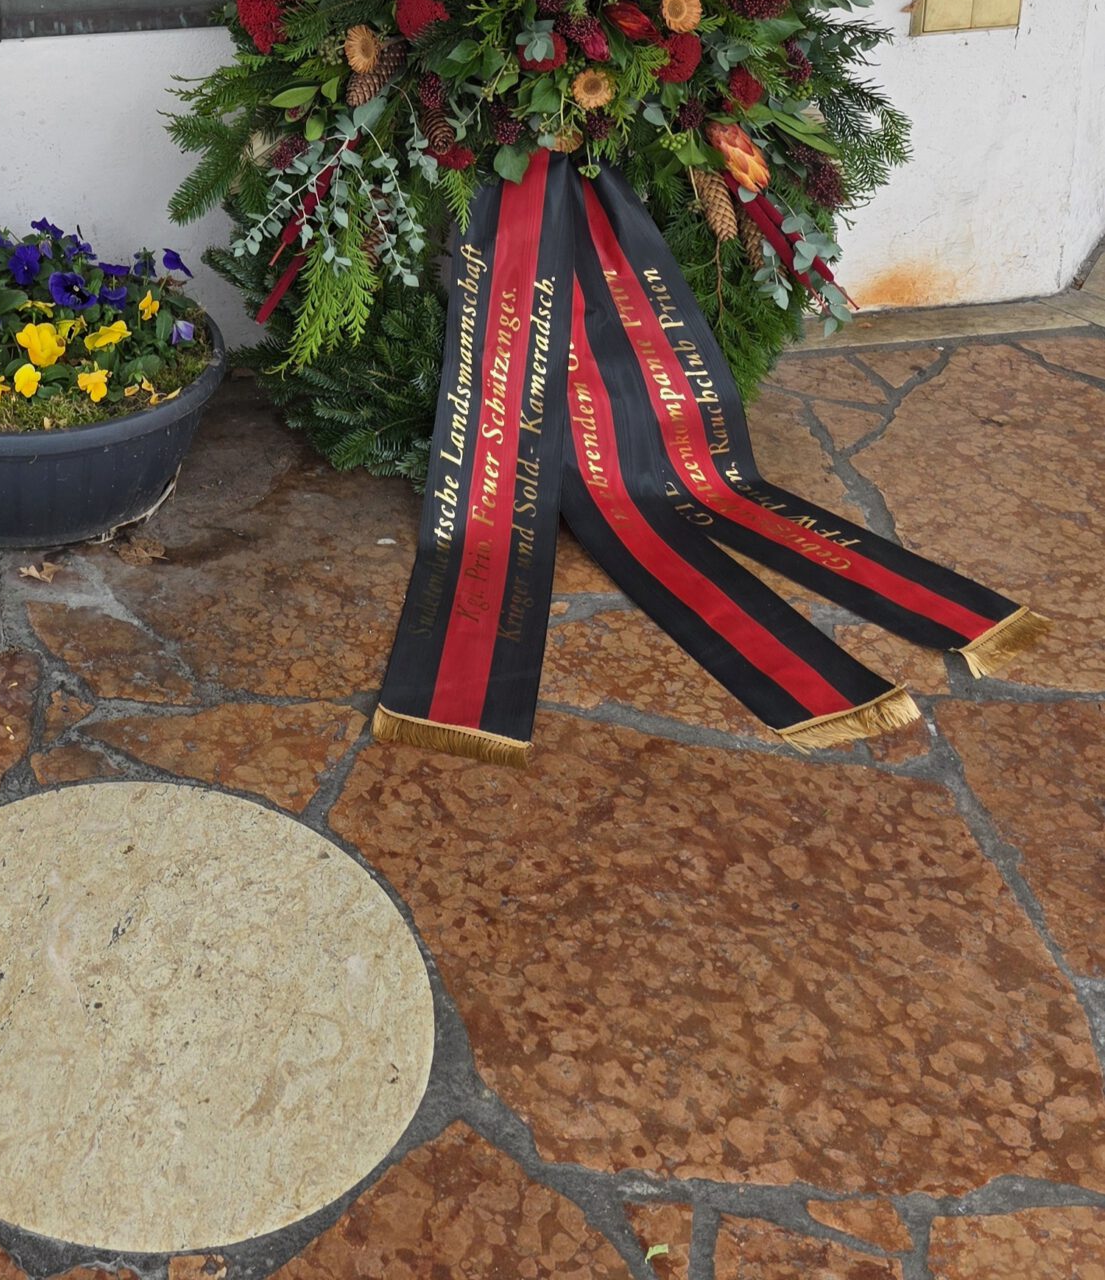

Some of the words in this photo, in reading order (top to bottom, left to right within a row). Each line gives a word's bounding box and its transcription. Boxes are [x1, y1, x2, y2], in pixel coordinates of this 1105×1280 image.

[643, 267, 685, 330] Prien
[482, 287, 521, 445] Schützenges.
[520, 276, 556, 435] Kameradsch.
[673, 339, 730, 456] Rauchclub
[408, 474, 460, 640] Sudetendeutsche
[440, 243, 488, 468] Landsmannschaft
[471, 452, 500, 527] Feuer
[512, 522, 536, 569] und
[498, 576, 535, 642] Krieger
